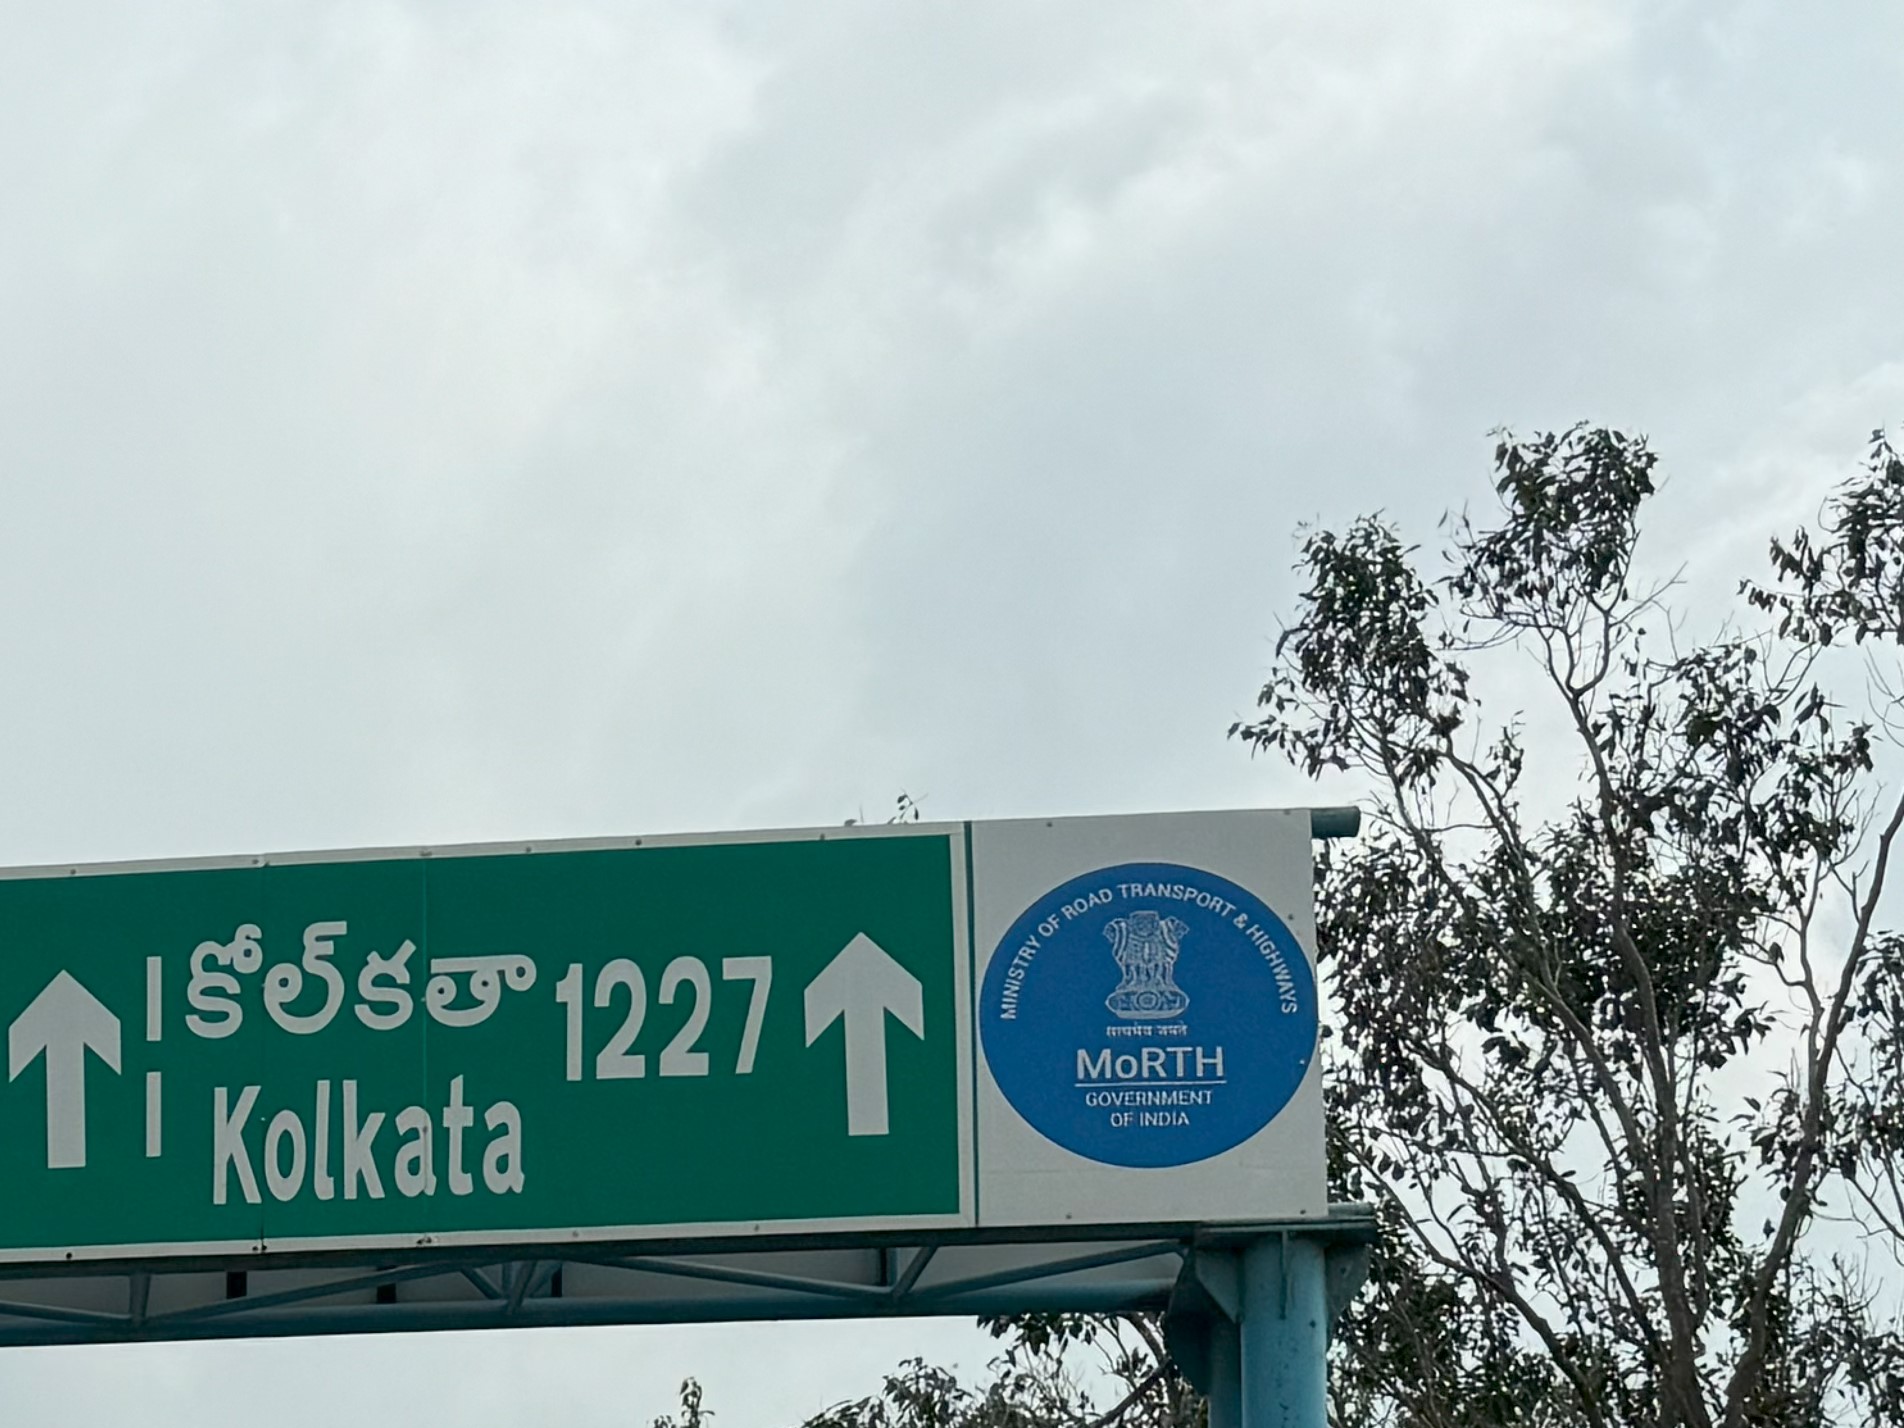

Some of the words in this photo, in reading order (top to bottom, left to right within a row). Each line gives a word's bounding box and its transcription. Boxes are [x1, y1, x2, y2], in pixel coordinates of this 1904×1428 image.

[1000, 935, 1041, 1019] MINISTRY
[1038, 914, 1060, 937] OF
[1061, 888, 1113, 920] ROAD
[1117, 883, 1236, 917] TRANSPORT
[1233, 913, 1249, 929] &
[1245, 924, 1298, 1013] HIGHWAYS
[556, 956, 772, 1080] 1227
[1077, 1046, 1224, 1079] MoRTH
[1085, 1090, 1212, 1106] GOVERNMENT
[214, 1075, 524, 1204] Kolkata
[1110, 1111, 1133, 1127] OF
[1140, 1110, 1190, 1127] INDIA
